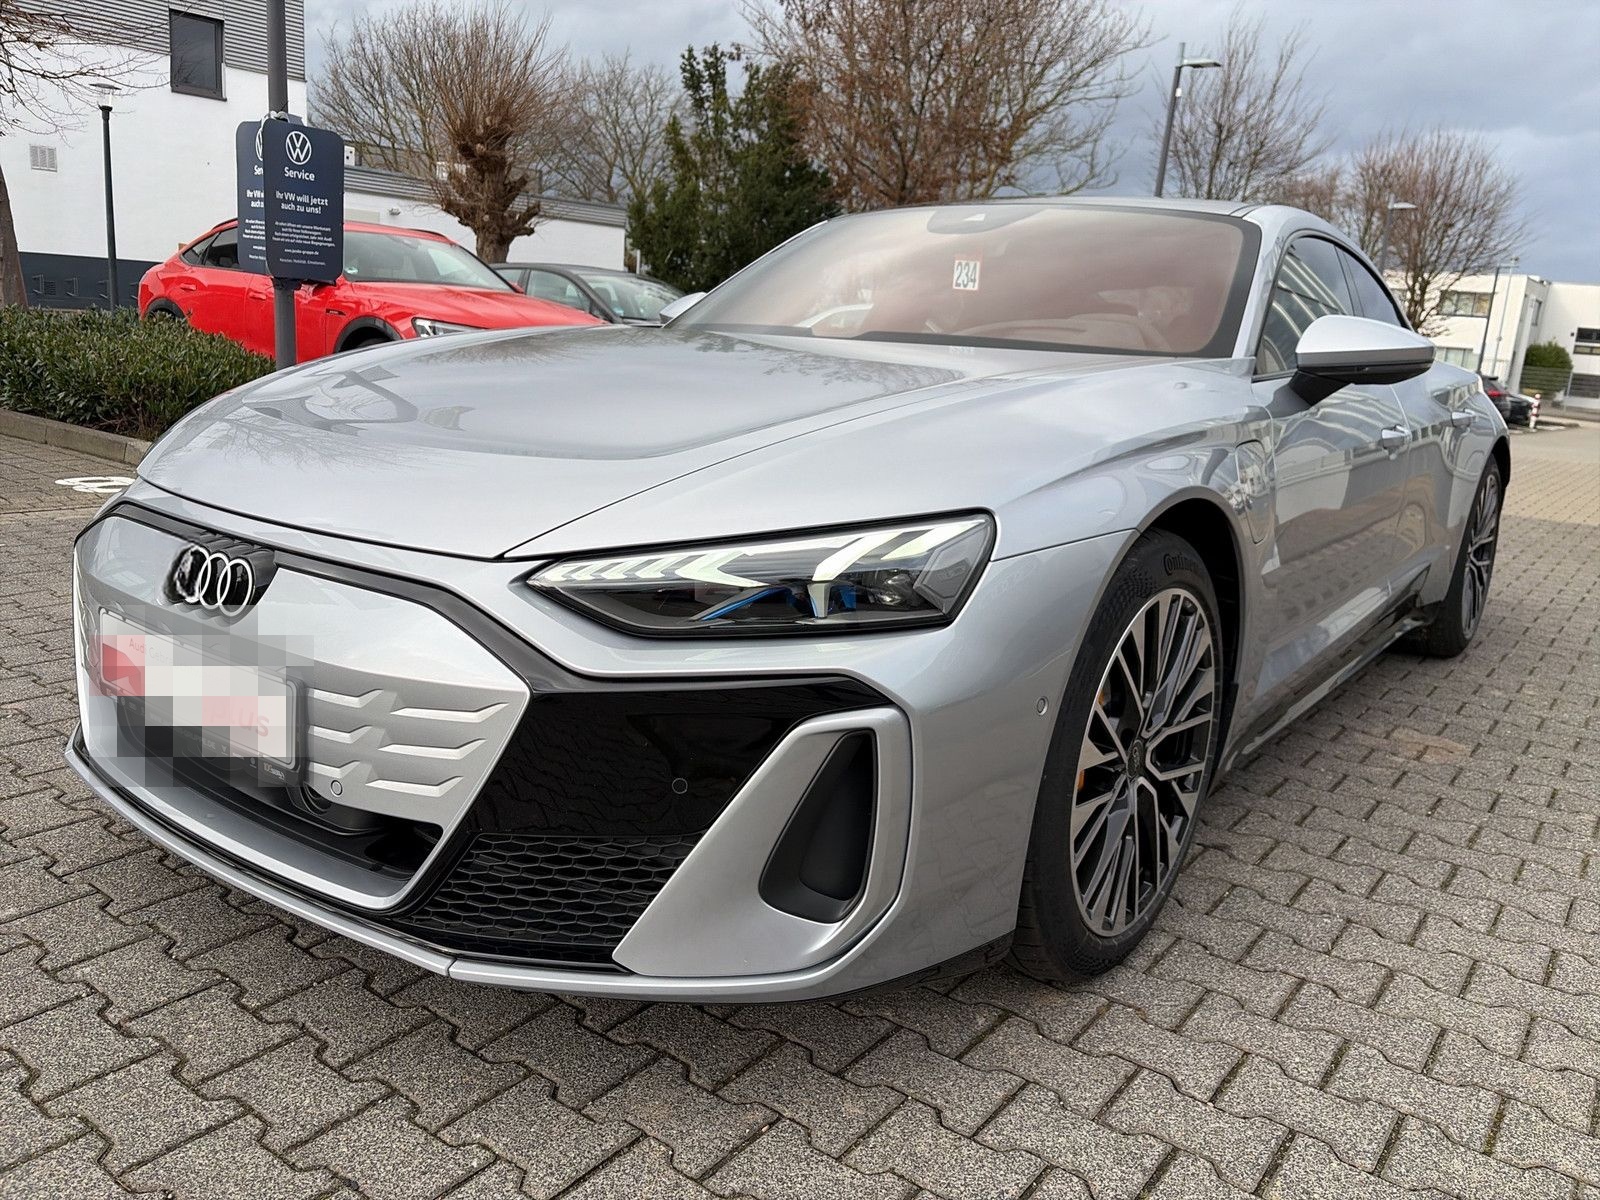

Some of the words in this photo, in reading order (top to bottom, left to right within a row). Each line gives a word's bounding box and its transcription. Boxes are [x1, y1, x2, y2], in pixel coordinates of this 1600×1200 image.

[284, 166, 315, 181] Service
[275, 190, 284, 199] Ihr
[284, 193, 296, 202] VW
[296, 194, 310, 203] will
[310, 195, 328, 206] jetzt
[280, 202, 295, 211] auch
[296, 205, 305, 213] zu
[305, 206, 321, 214] uns!
[954, 261, 977, 288] 234
